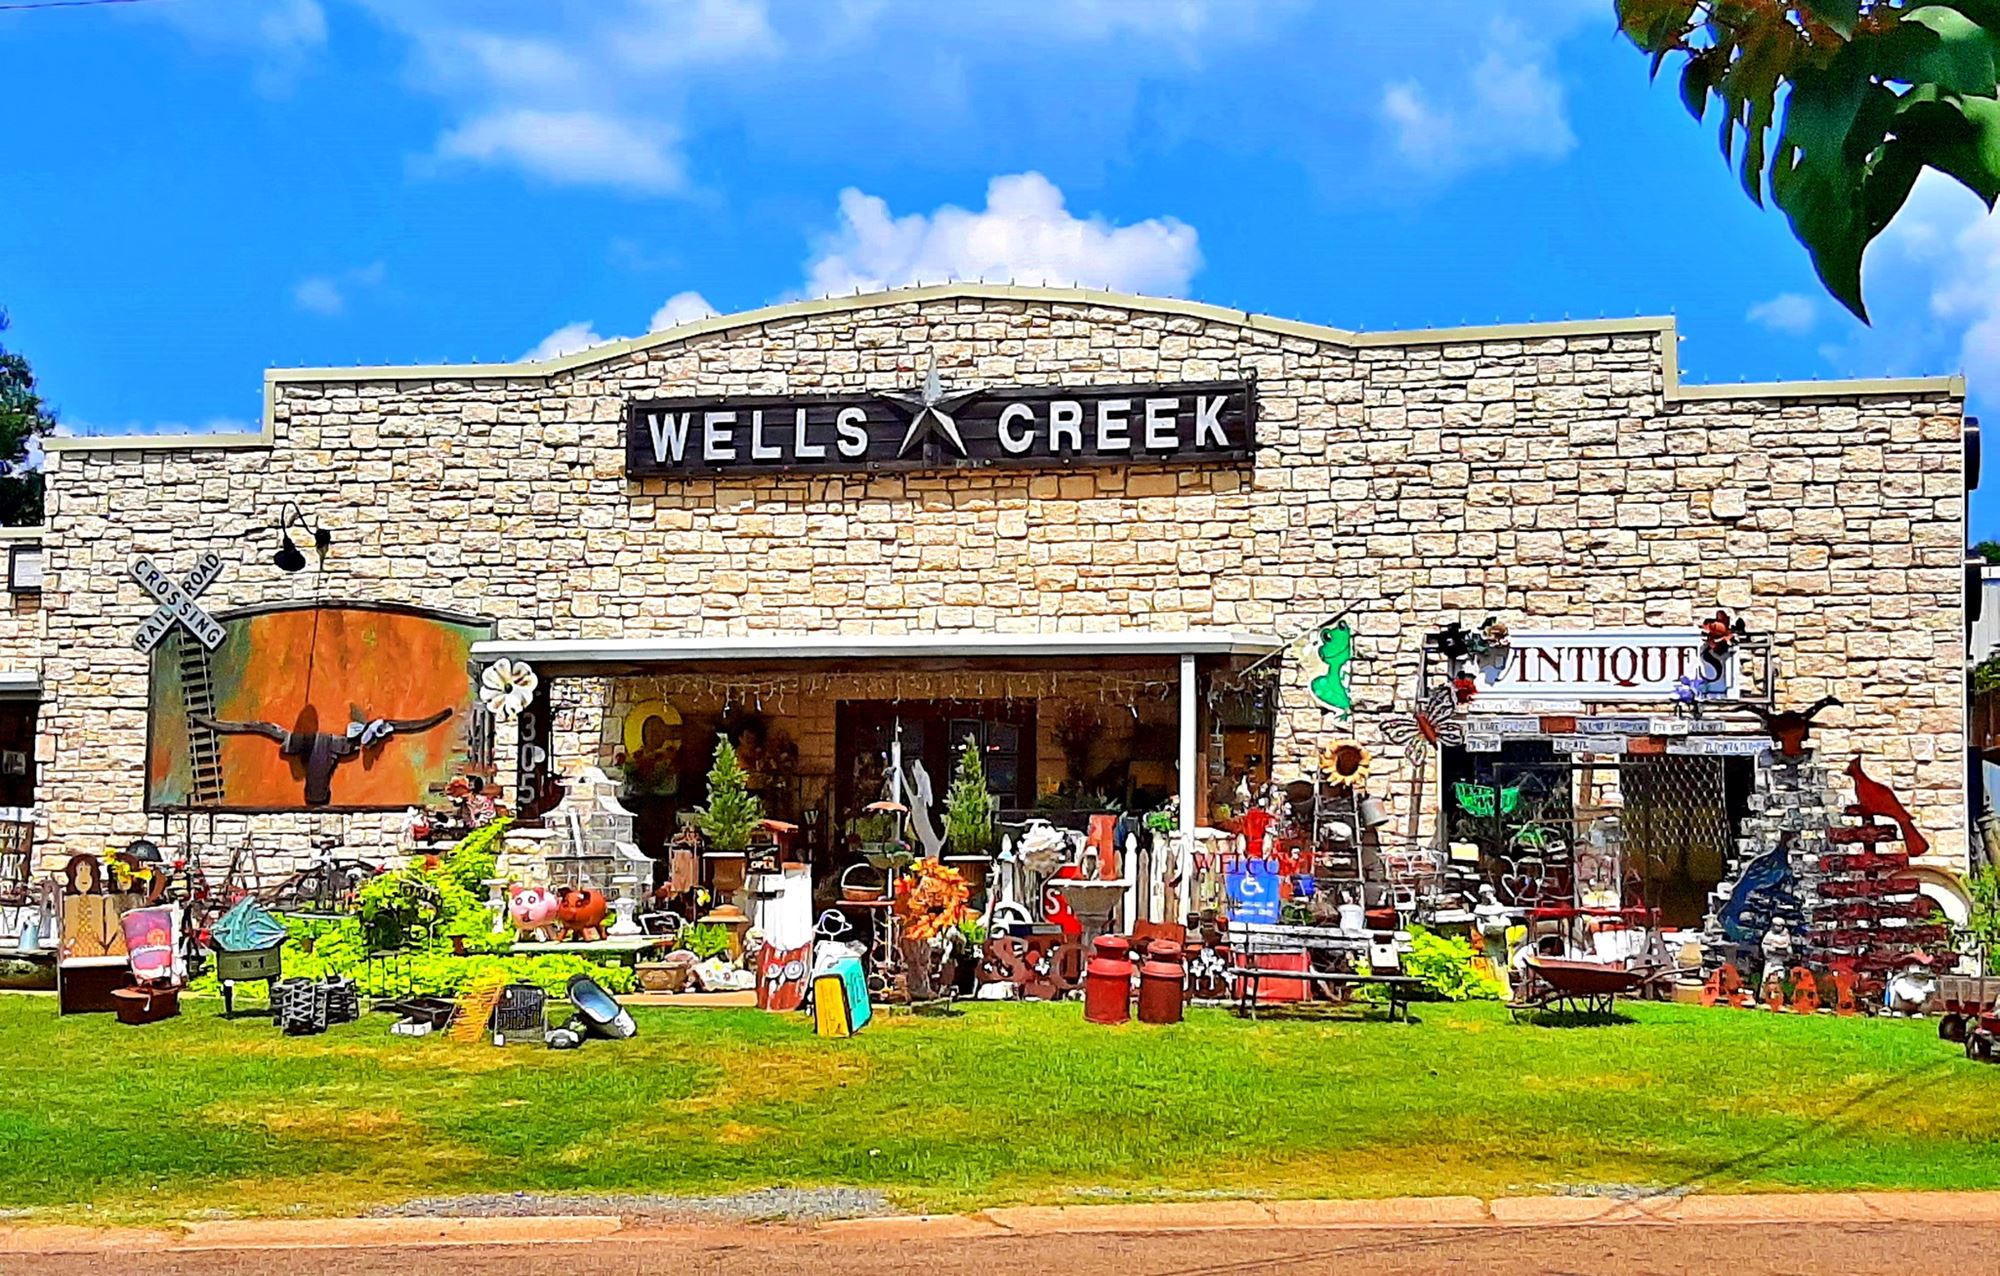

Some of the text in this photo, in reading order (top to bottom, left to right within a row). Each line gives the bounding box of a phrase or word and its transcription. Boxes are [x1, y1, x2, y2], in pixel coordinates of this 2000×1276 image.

[647, 395, 1231, 463] WELLS CREEK
[134, 560, 221, 643] CROSSING
[135, 553, 220, 649] RAIL ROAD
[1496, 645, 1728, 688] ANTIQUES
[508, 711, 537, 804] 305
